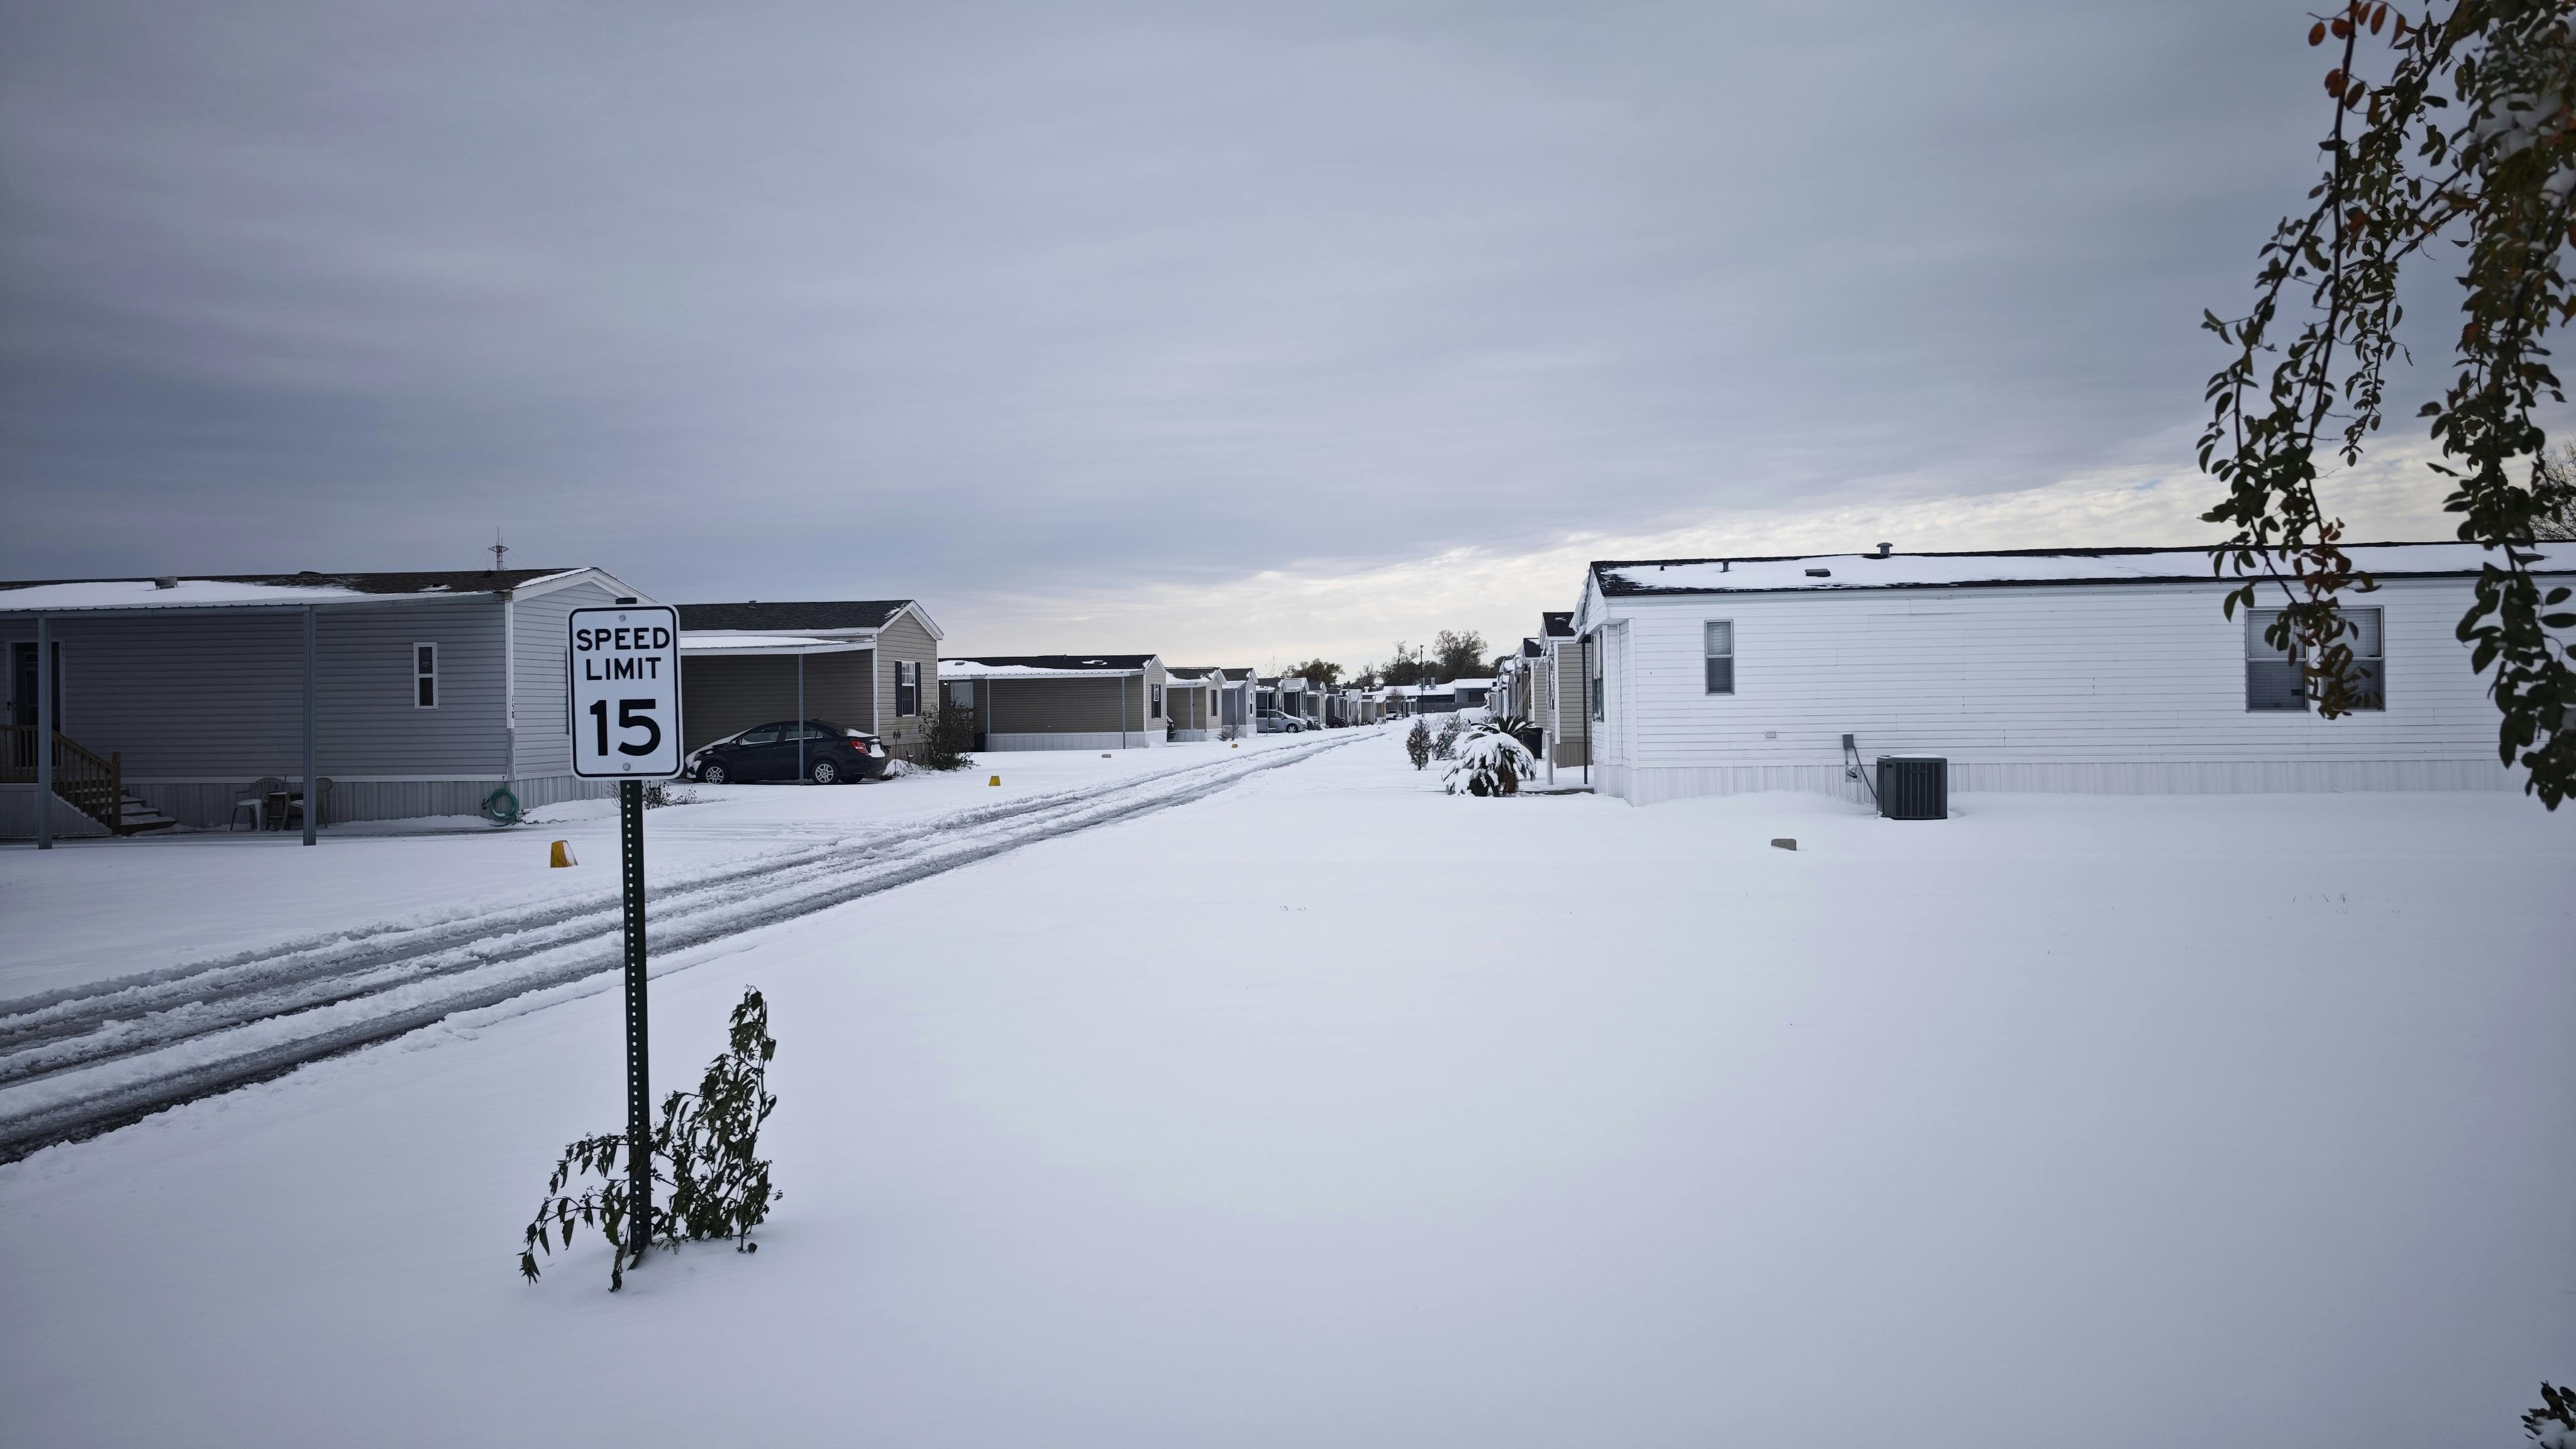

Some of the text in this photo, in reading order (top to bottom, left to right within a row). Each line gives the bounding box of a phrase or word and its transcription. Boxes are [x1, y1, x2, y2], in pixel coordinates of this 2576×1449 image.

[576, 627, 670, 652] SPEED
[586, 657, 661, 680] LIMIT
[590, 699, 661, 757] 15
